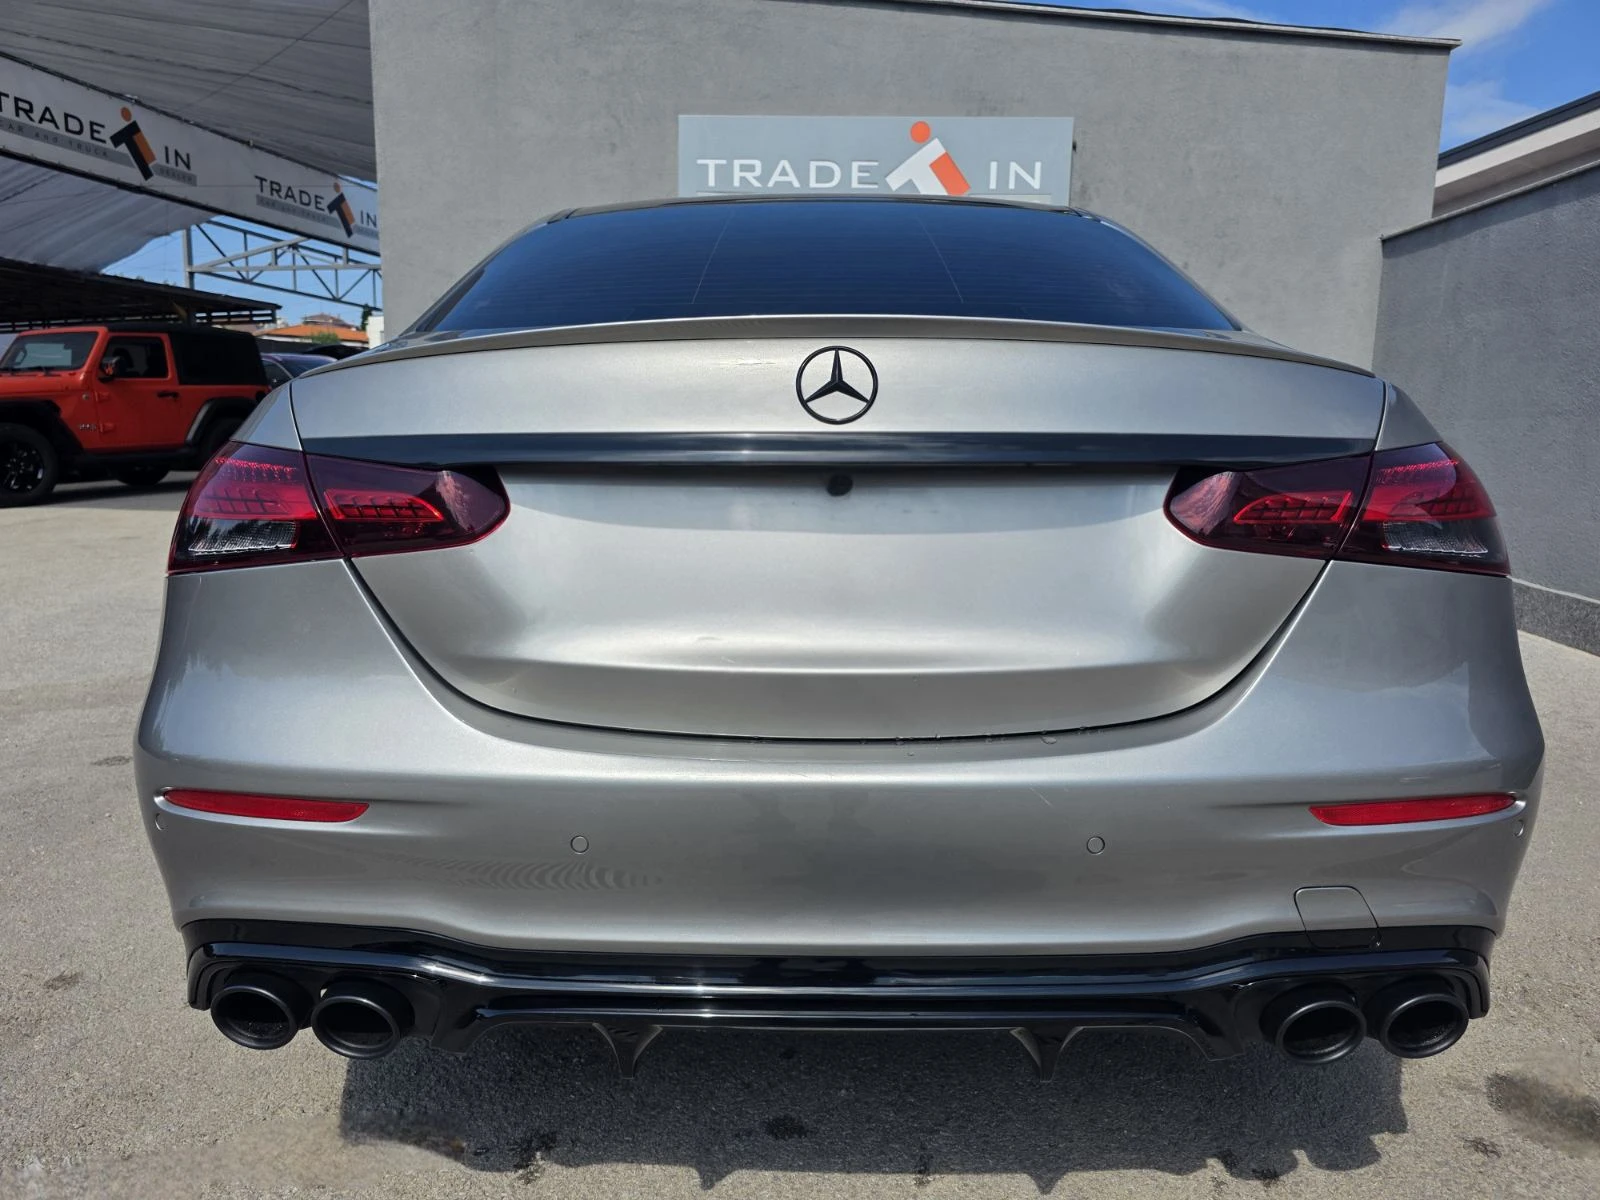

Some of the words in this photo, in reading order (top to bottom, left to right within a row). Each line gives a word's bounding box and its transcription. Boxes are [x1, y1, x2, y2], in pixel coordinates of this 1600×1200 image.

[164, 145, 191, 171] IN
[697, 159, 879, 189] TRADE
[989, 161, 1042, 190] IN
[254, 175, 325, 211] TRADE
[360, 210, 377, 228] IN
